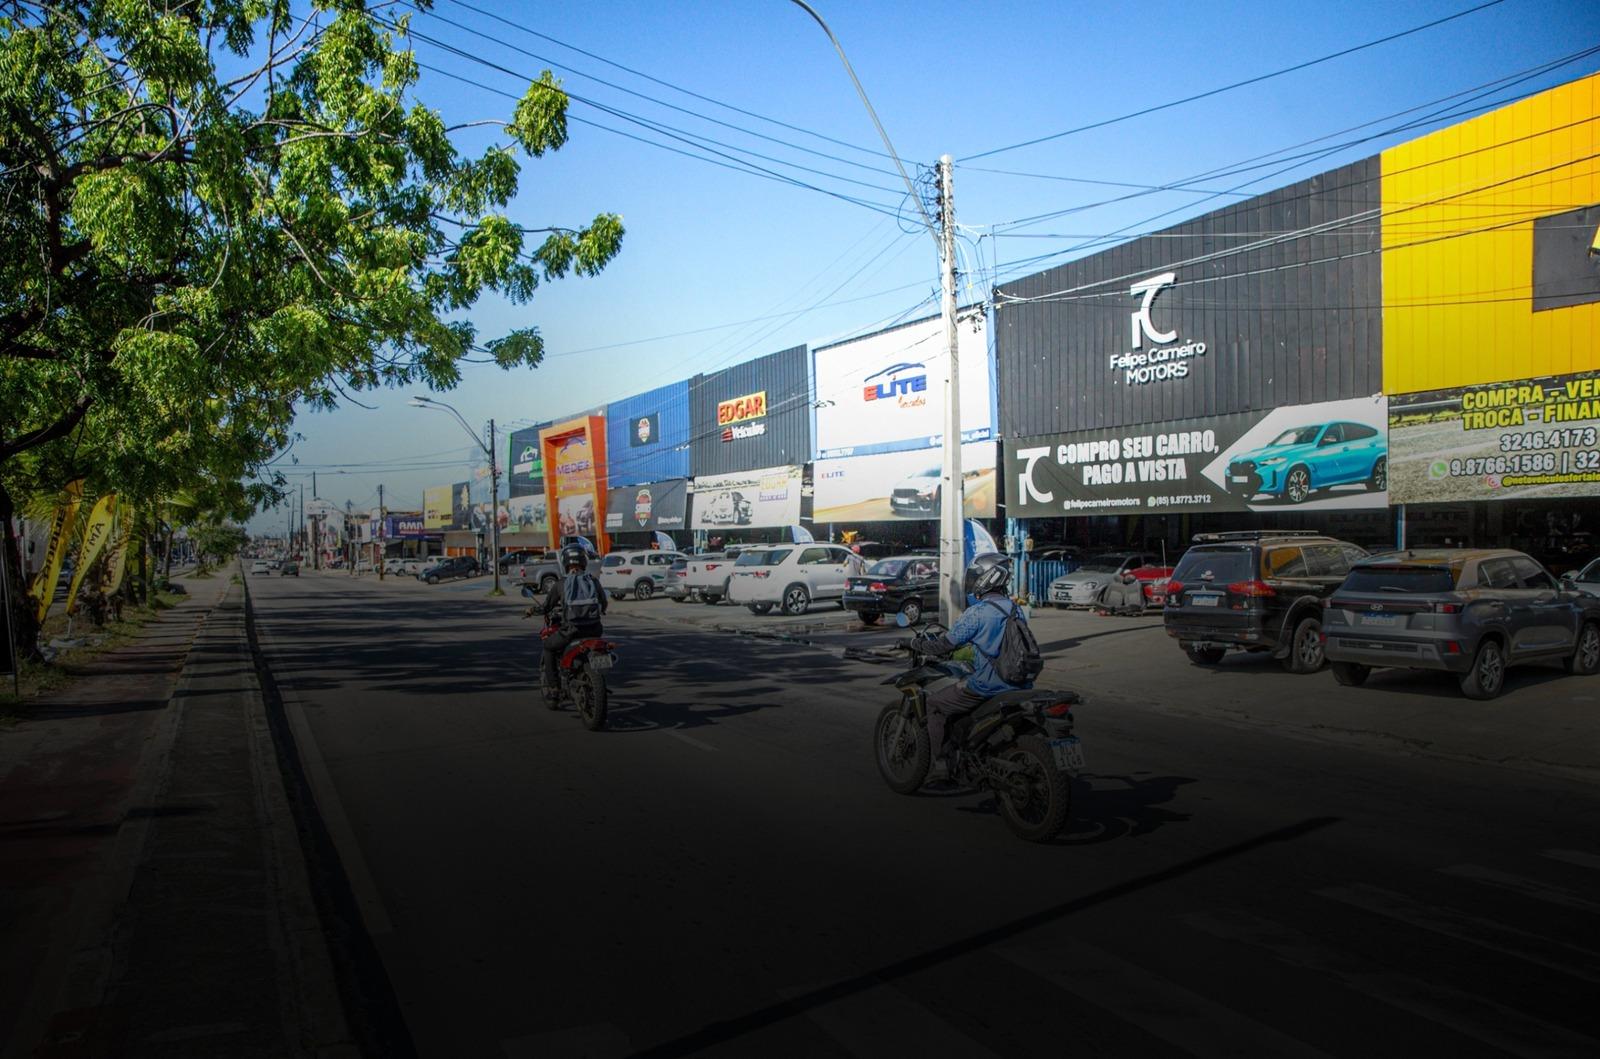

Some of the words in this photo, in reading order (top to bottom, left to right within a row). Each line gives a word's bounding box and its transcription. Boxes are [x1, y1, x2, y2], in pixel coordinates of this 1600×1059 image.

[1110, 353, 1146, 371] Felipe
[1147, 339, 1206, 361] Carneiro
[1126, 361, 1188, 385] MOTORS
[864, 375, 927, 402] ELITE
[1462, 385, 1544, 410] COMPRA
[718, 396, 764, 423] EDGAR
[1462, 407, 1524, 430] TROCA
[1057, 439, 1120, 465] COMPRO
[1122, 436, 1152, 459] SEU
[1156, 429, 1219, 455] CARRO,
[1500, 426, 1596, 452] 3246.4173
[1083, 462, 1123, 486] PAGO
[1125, 462, 1136, 483] A
[1138, 458, 1187, 482] VISTA
[1450, 452, 1555, 478] 9.8766.1586
